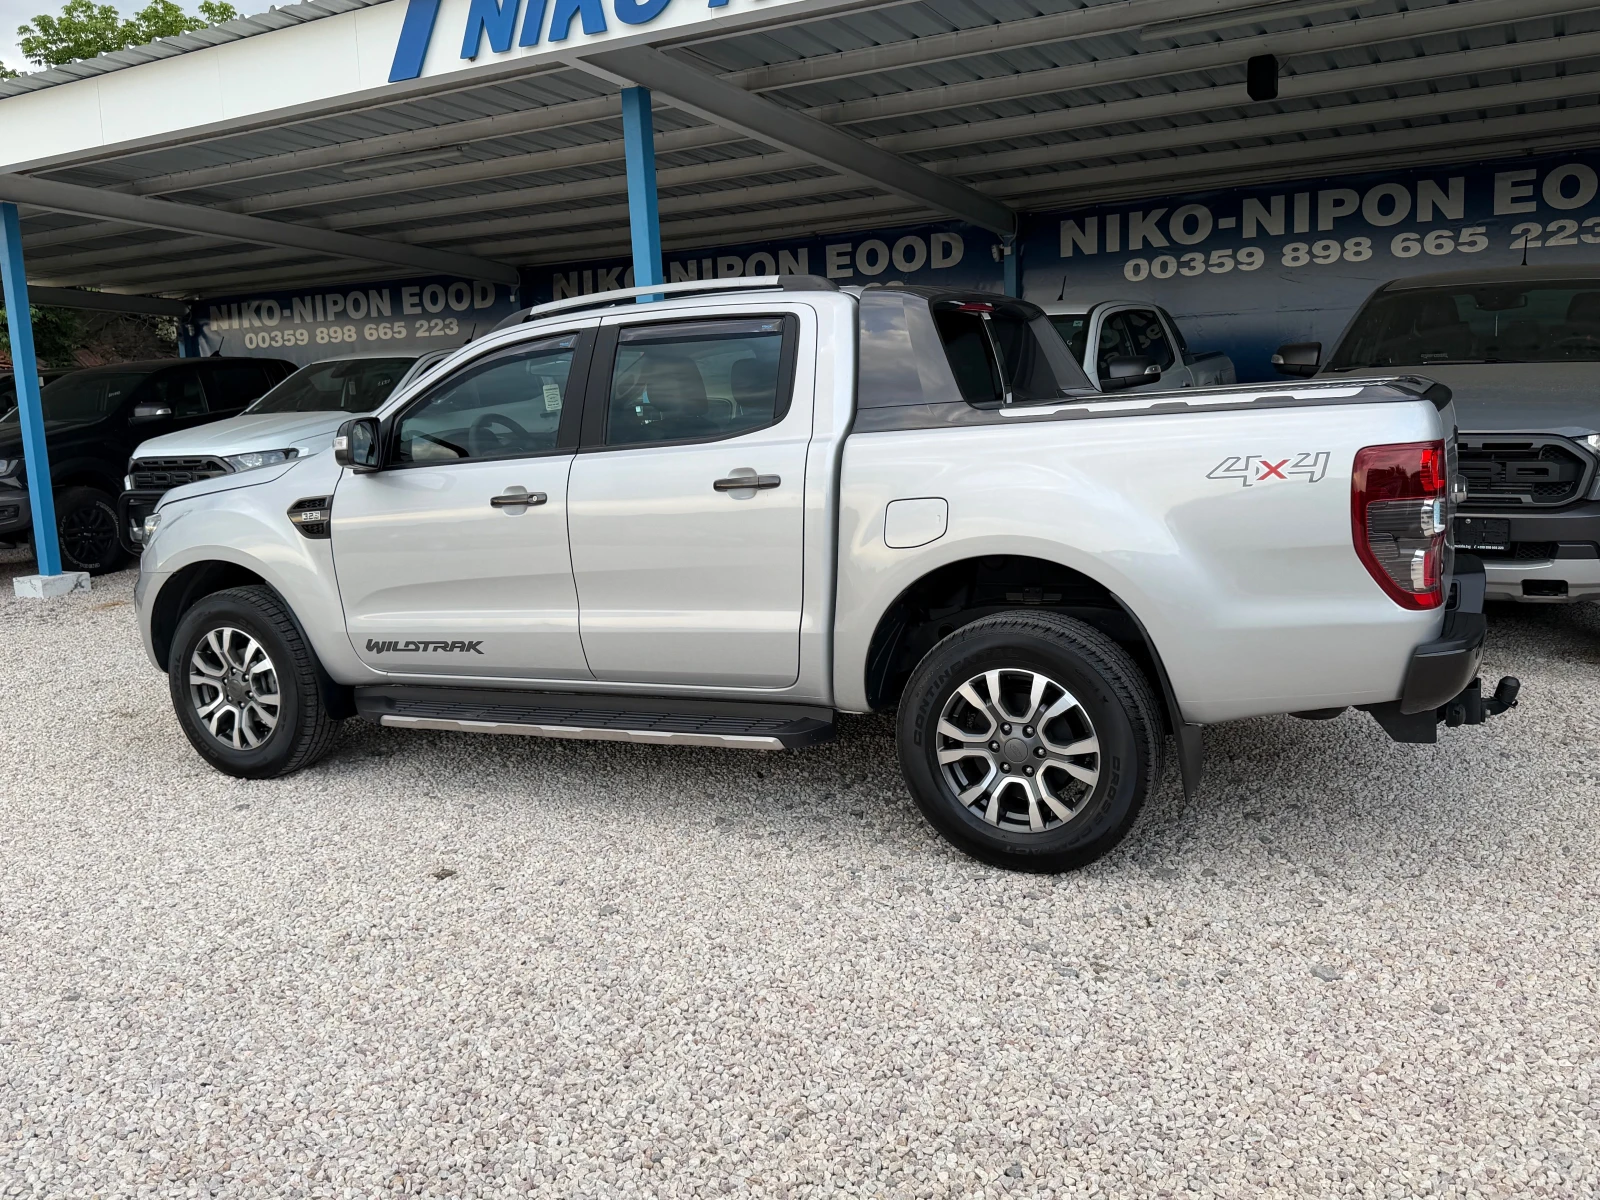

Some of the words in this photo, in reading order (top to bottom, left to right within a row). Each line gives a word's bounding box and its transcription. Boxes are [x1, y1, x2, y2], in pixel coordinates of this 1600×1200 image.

[1060, 175, 1465, 257] NIKO-NIPON
[826, 232, 965, 279] EOOD
[1124, 246, 1265, 281] 00359
[1281, 236, 1373, 267] 898
[1390, 226, 1489, 258] 665
[1510, 216, 1600, 249] 223
[209, 288, 392, 331] NIKO-NIPON
[402, 280, 496, 315] EOOD
[244, 325, 309, 349] 00359
[315, 325, 357, 344] 898
[364, 322, 407, 340] 665
[416, 317, 459, 337] 223
[365, 638, 485, 655] WILDTRAK
